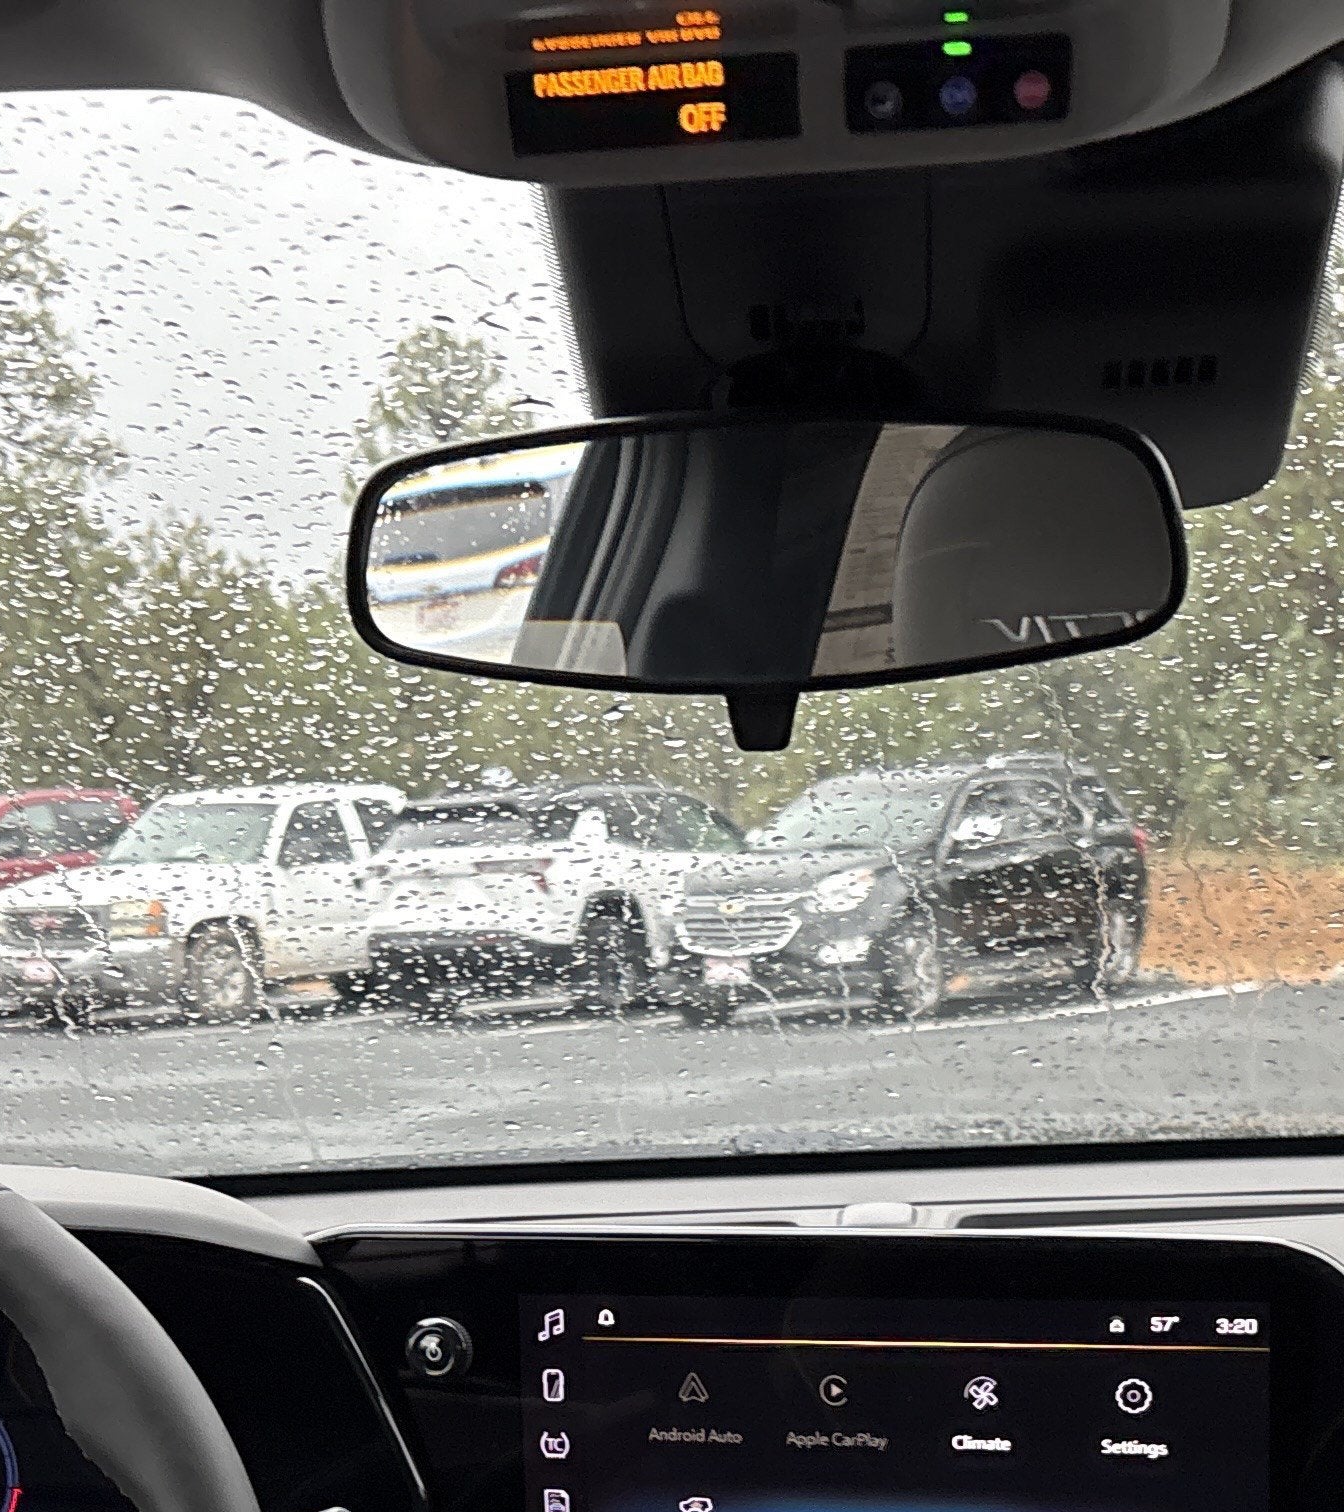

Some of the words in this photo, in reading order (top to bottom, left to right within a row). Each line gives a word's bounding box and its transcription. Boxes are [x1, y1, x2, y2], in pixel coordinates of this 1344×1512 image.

[533, 66, 647, 98] PASSENGER
[678, 101, 727, 134] OFF
[1215, 1318, 1258, 1334] 3:20
[648, 1427, 705, 1443] Android
[707, 1428, 744, 1445] Auto
[785, 1431, 831, 1448] Apple
[831, 1432, 890, 1450] CarPlay
[951, 1434, 1012, 1452] Climate
[1100, 1438, 1169, 1459] Settings
